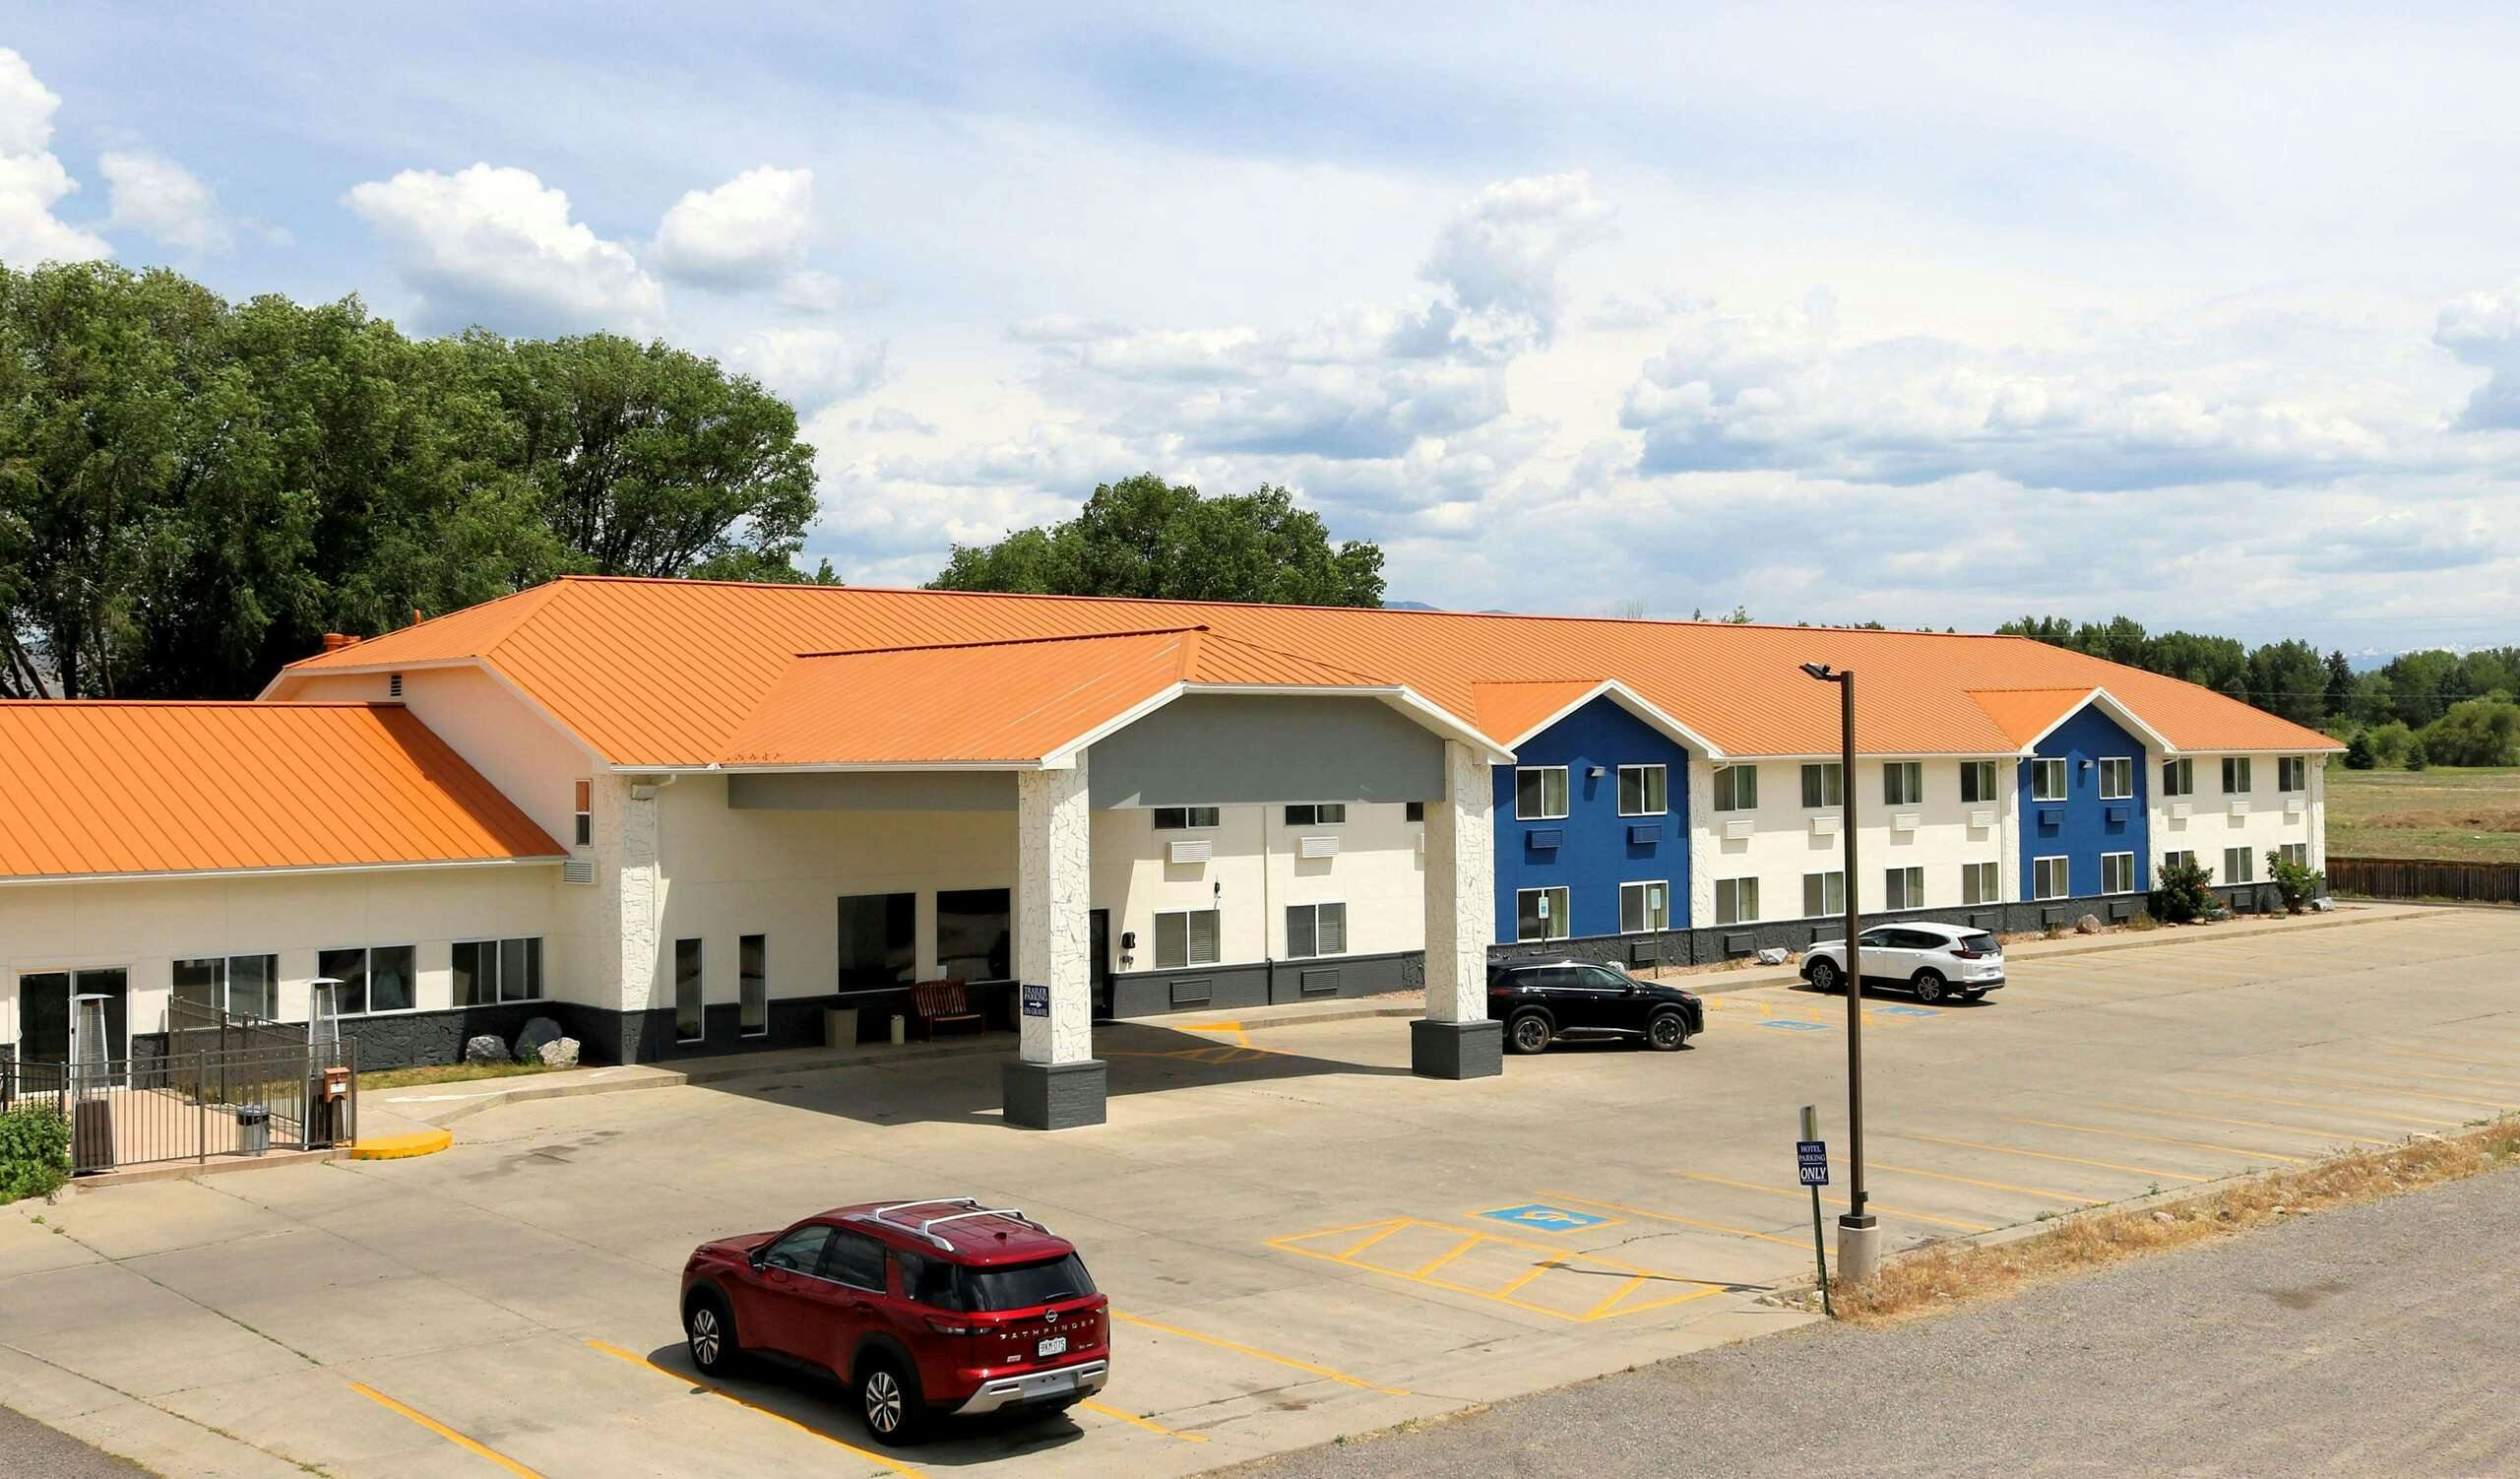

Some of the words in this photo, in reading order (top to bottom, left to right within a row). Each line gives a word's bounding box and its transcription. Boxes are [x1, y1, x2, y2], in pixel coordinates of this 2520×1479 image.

[1024, 993, 1047, 1001] PARKING
[1800, 1167, 1827, 1179] ONLY
[999, 1318, 1095, 1340] PATHFINDER
